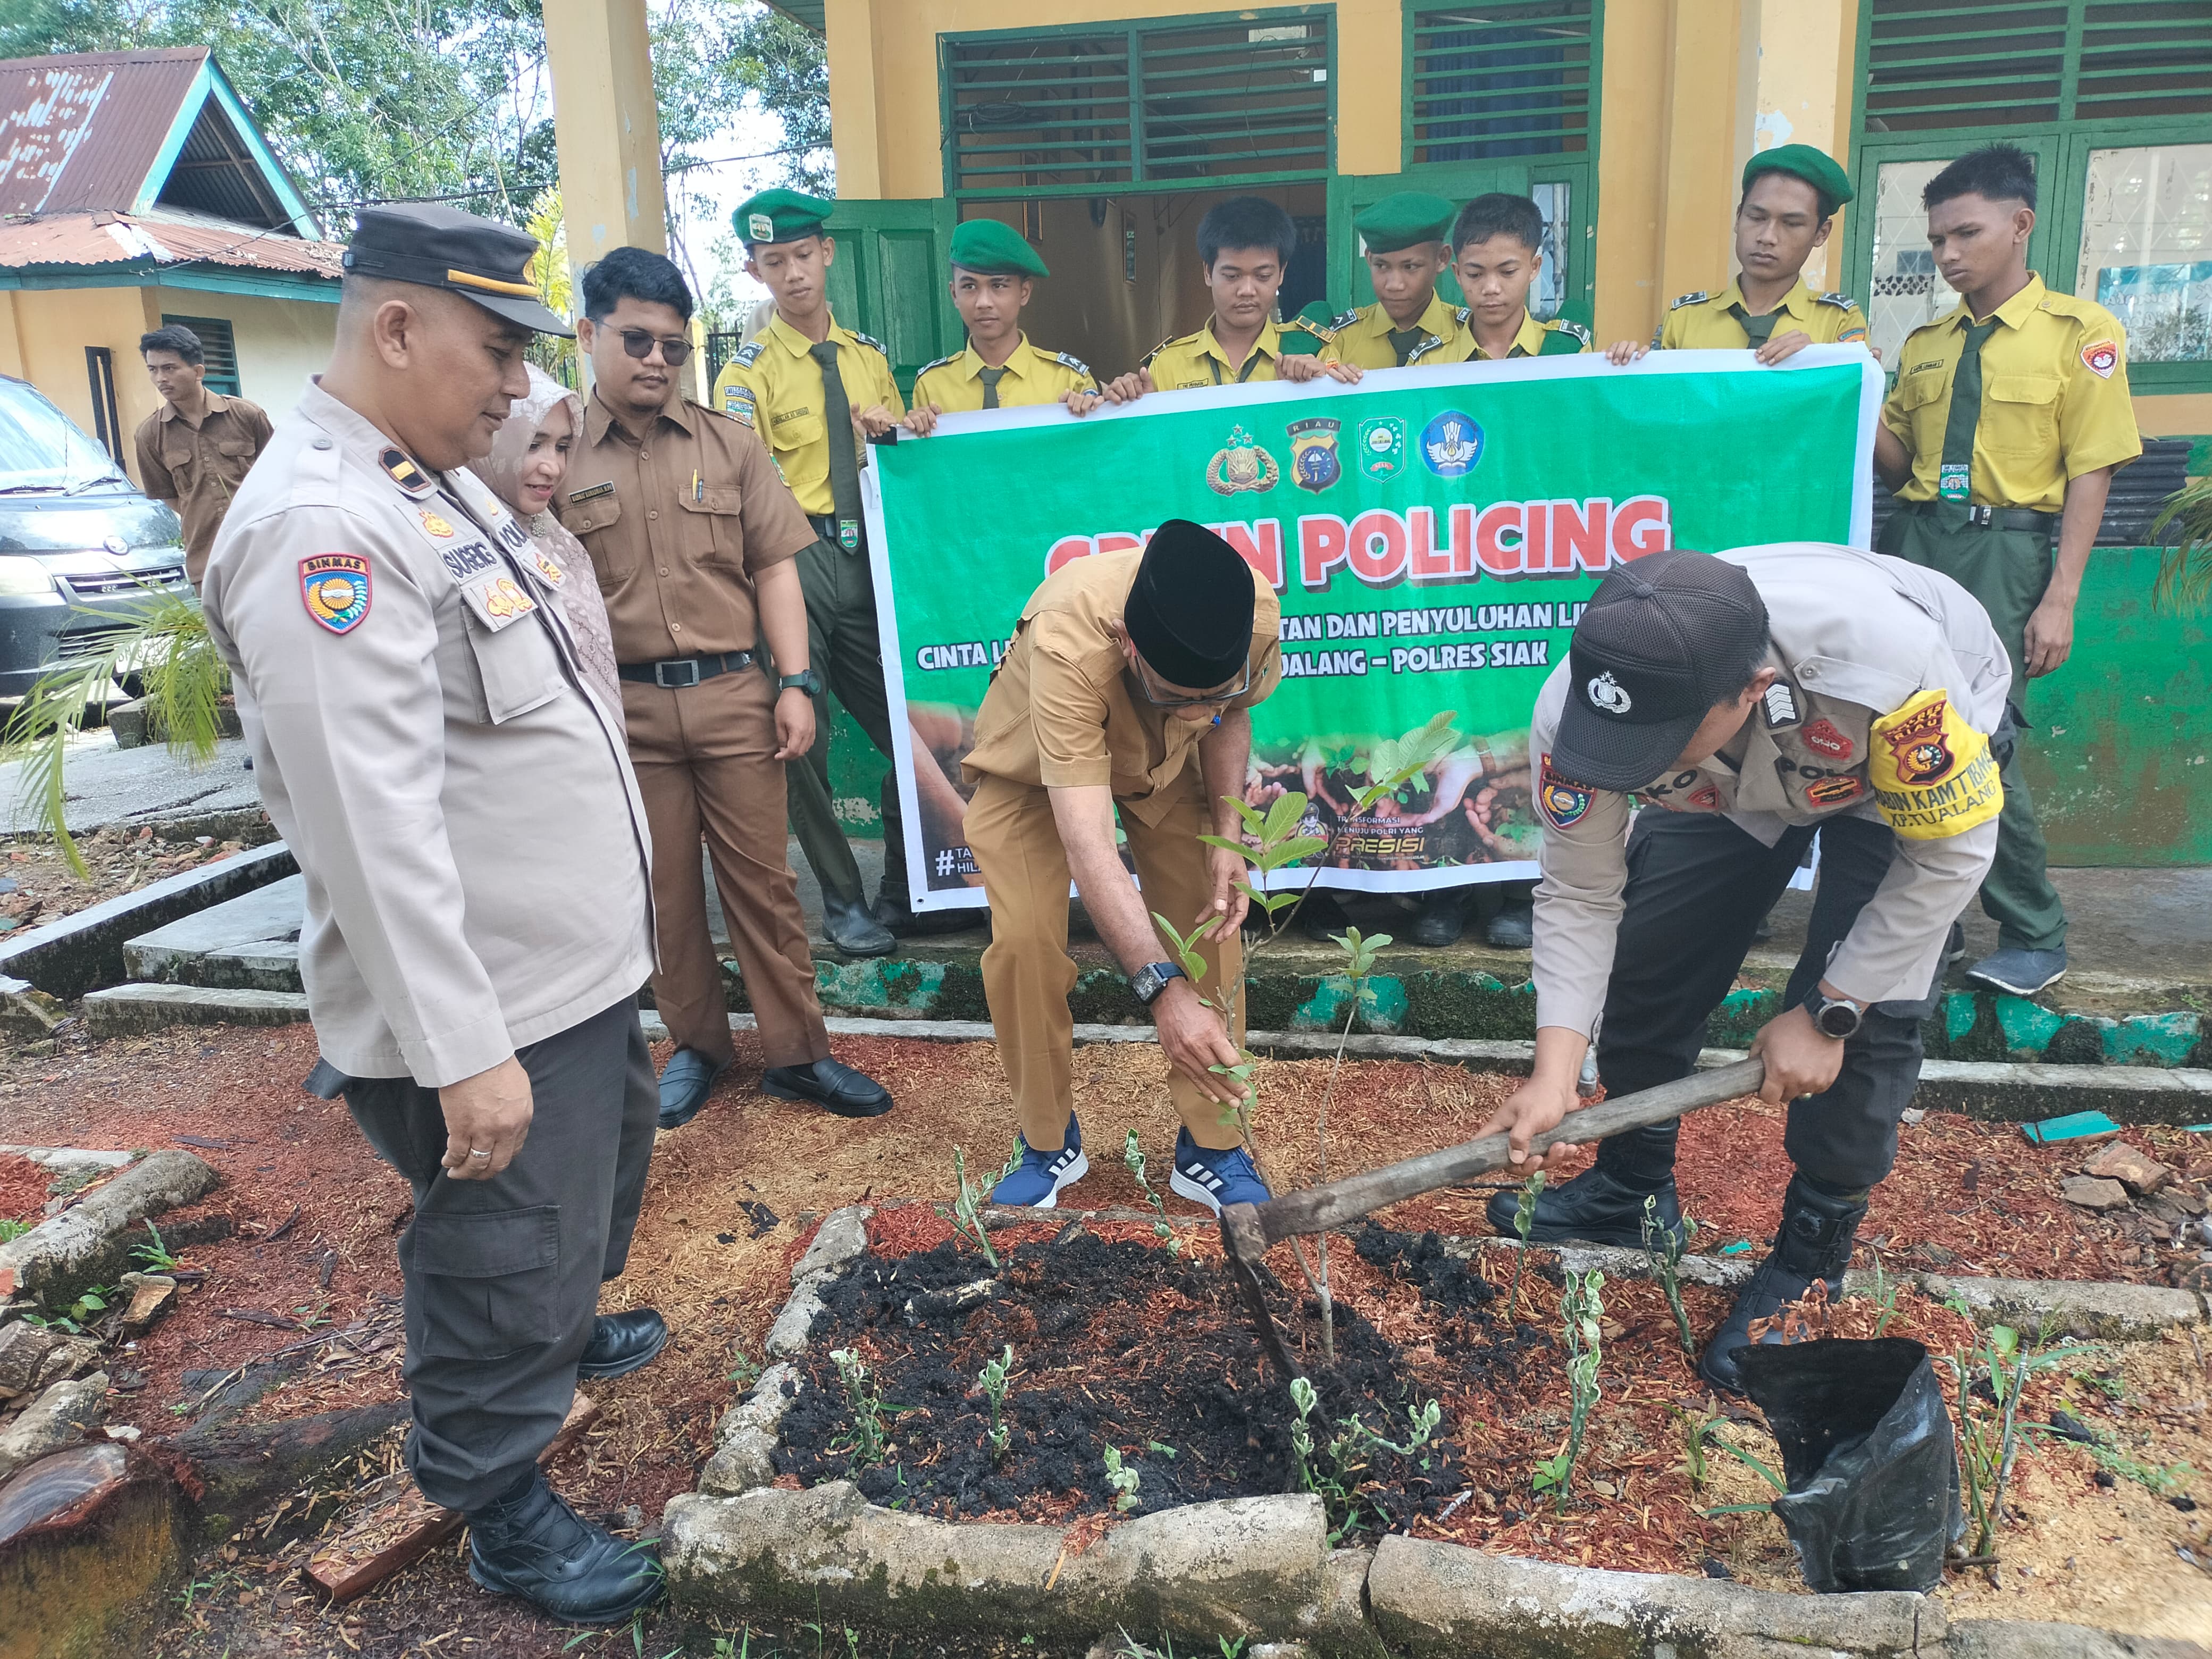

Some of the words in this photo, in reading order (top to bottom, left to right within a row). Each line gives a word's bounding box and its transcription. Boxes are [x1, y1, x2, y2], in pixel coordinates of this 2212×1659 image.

[1293, 421, 1335, 432] RIAU
[1297, 495, 1671, 585] POLICING
[307, 557, 361, 571] BINMAS
[443, 541, 497, 579] SUGENG
[1325, 613, 1378, 639] DAN
[1380, 602, 1553, 636] PENYULUHAN
[917, 642, 988, 671] CINTA
[991, 640, 1010, 664] L
[1390, 642, 1486, 674] POLRES
[1489, 640, 1549, 668] SIAK
[1335, 837, 1426, 853] PRESISI
[957, 862, 981, 873] HIL
